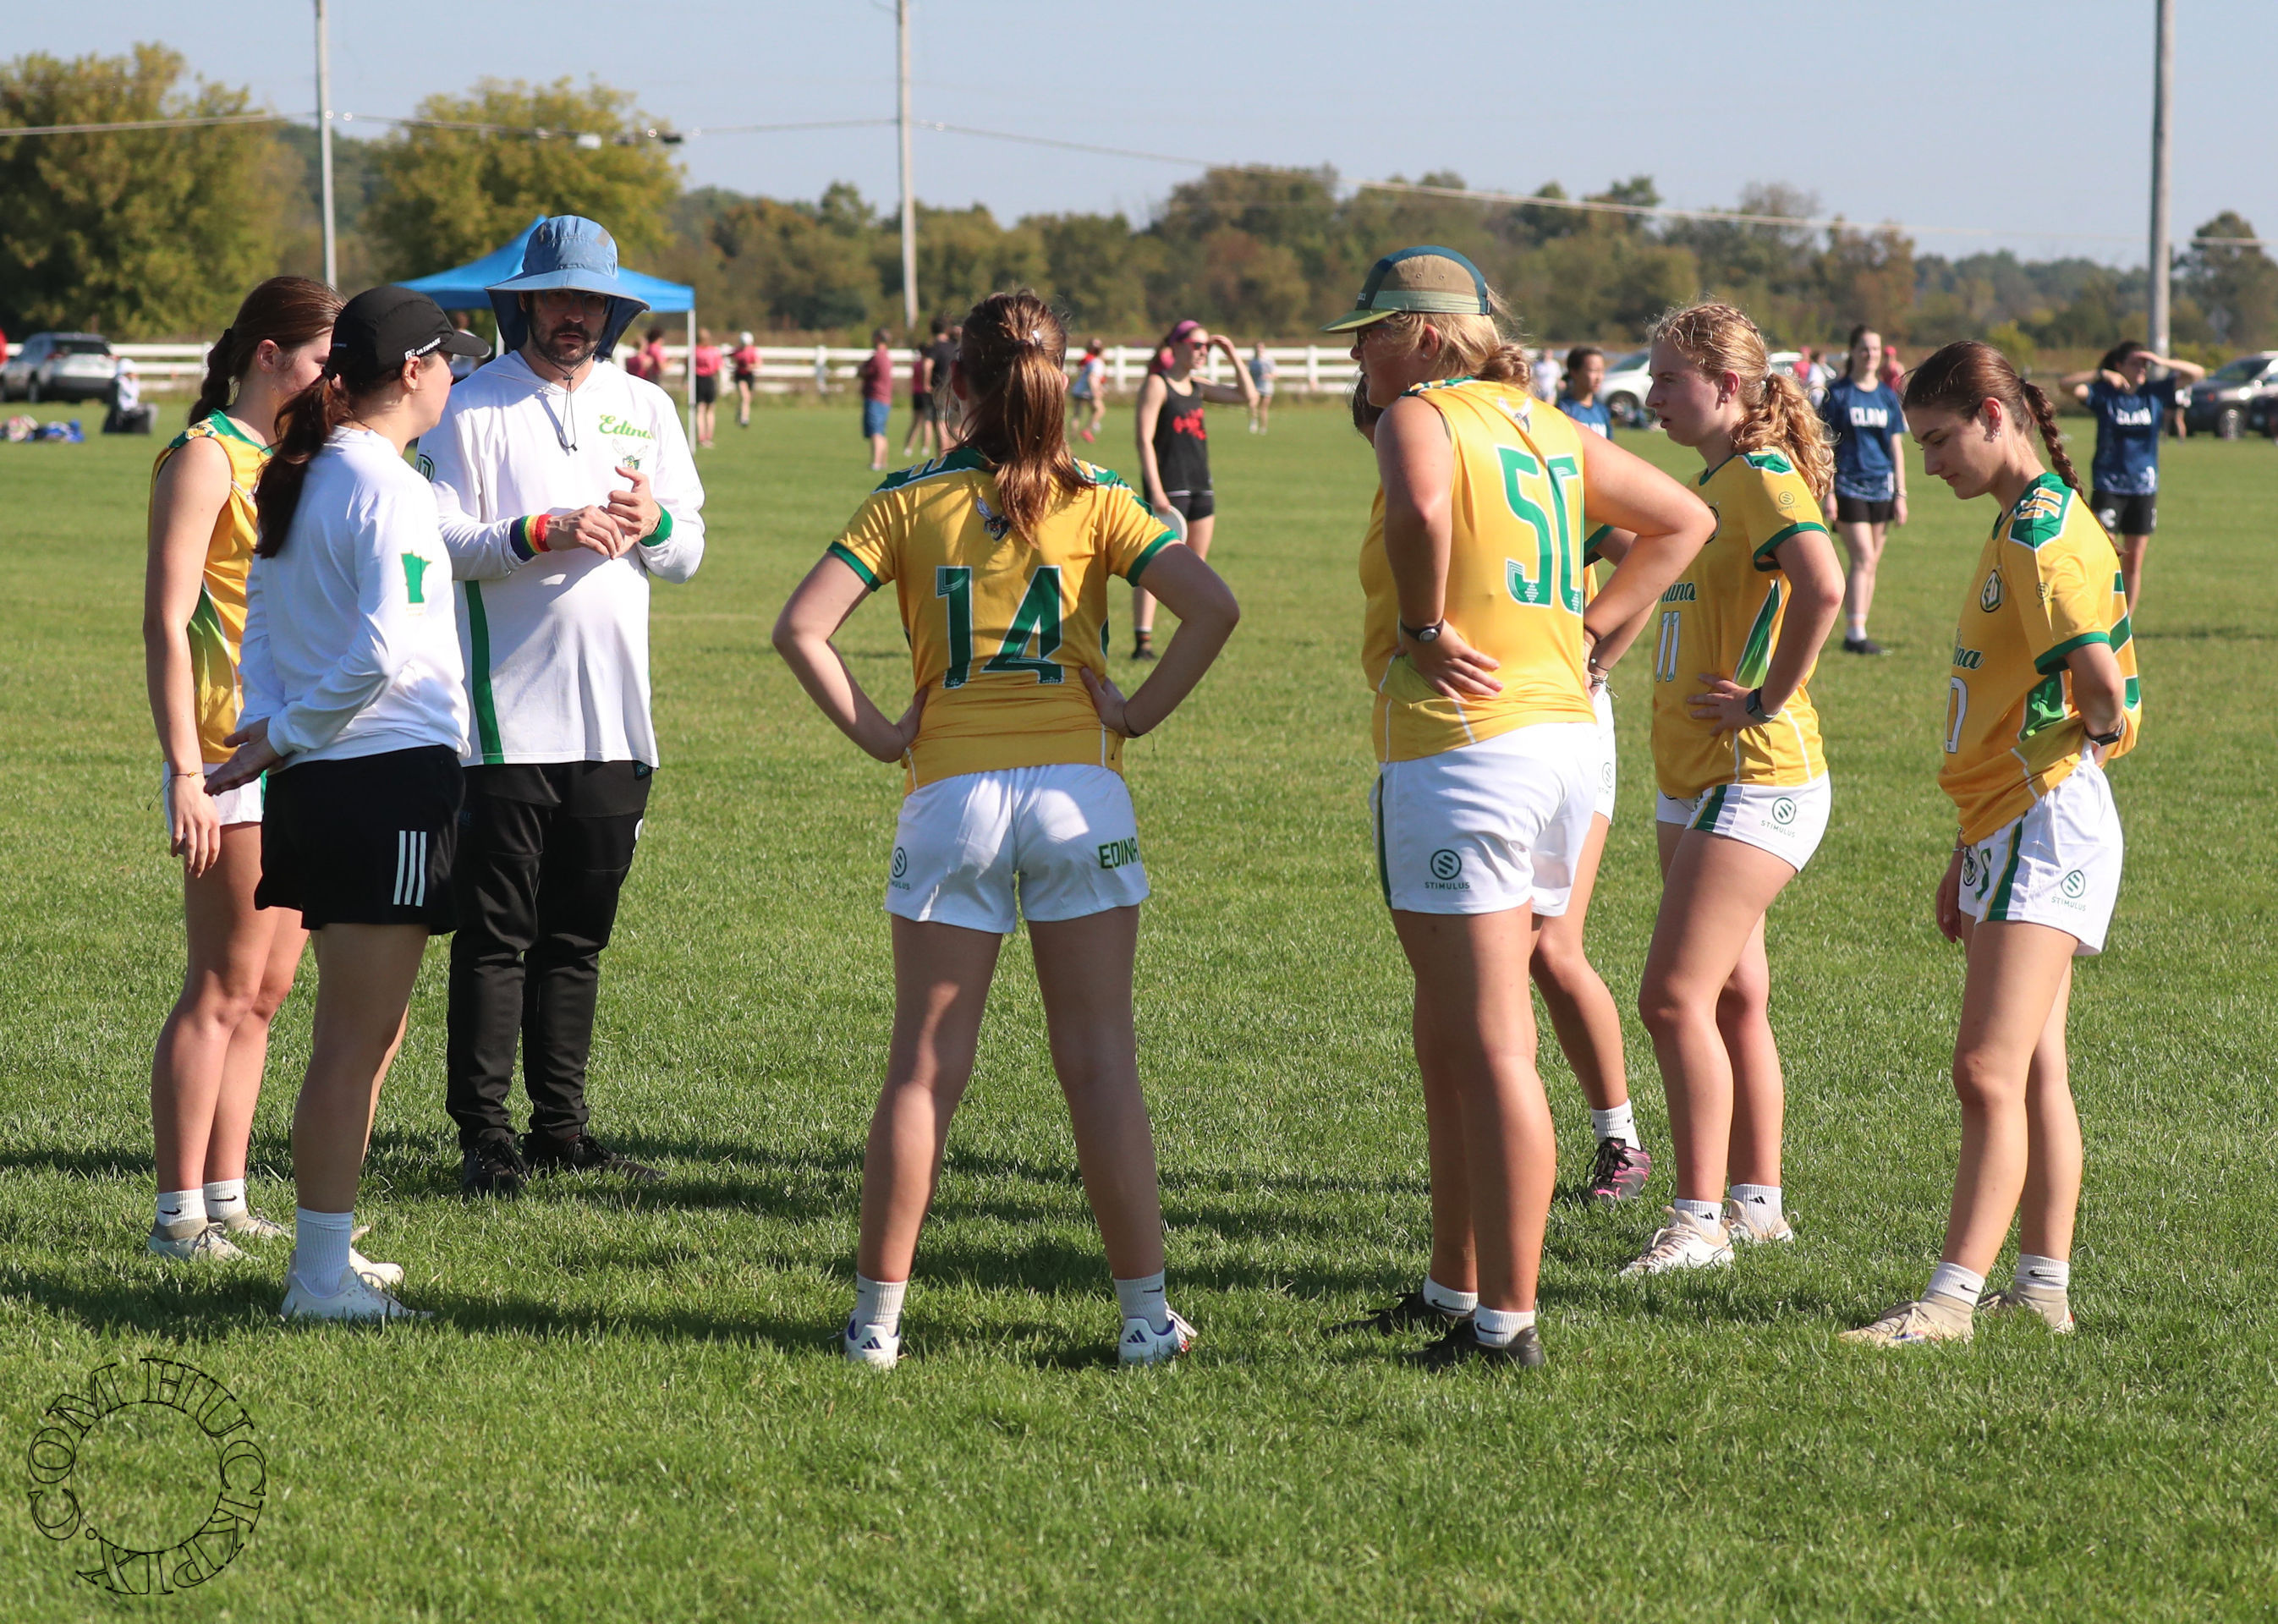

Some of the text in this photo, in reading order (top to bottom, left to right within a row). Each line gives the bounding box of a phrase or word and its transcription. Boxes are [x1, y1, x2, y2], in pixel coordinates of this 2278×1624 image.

[416, 337, 442, 356] ULTIMATE
[936, 565, 1064, 689] 14
[1655, 610, 1681, 683] 11
[1760, 820, 1796, 838] STIMULUS
[1098, 836, 1140, 870] EDINA
[1424, 881, 1471, 890] STIMULUS
[2050, 896, 2087, 913] STIMULUS
